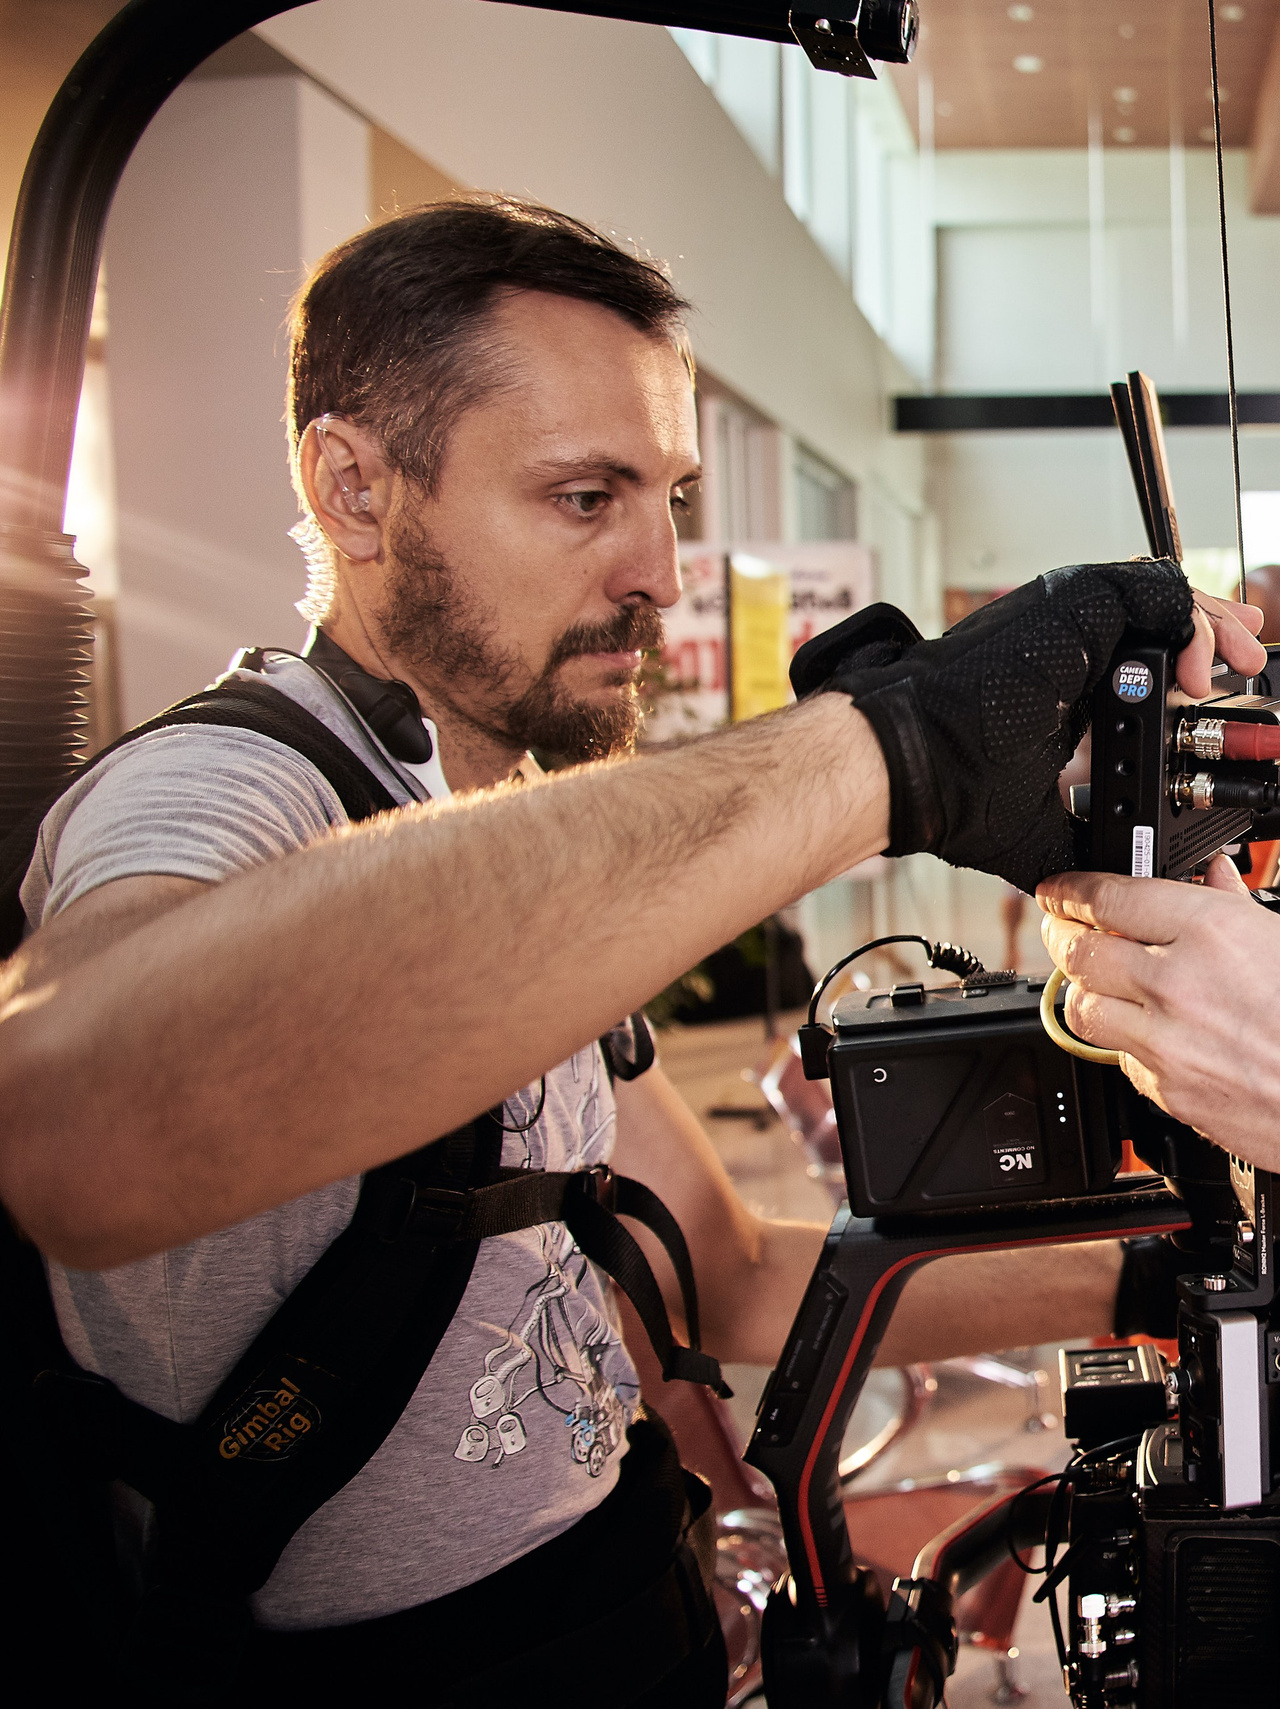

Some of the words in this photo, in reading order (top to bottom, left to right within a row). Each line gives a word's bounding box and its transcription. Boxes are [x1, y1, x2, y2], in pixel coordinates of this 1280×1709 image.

[1120, 666, 1149, 675] CAMERA
[1119, 674, 1148, 686] DEPT.
[1118, 684, 1148, 698] PRO
[1143, 831, 1151, 877] 190425-01-0
[993, 1146, 1026, 1154] COMMENTS
[999, 1152, 1033, 1171] NC
[219, 1377, 301, 1459] Gimbal
[263, 1412, 311, 1451] Rig
